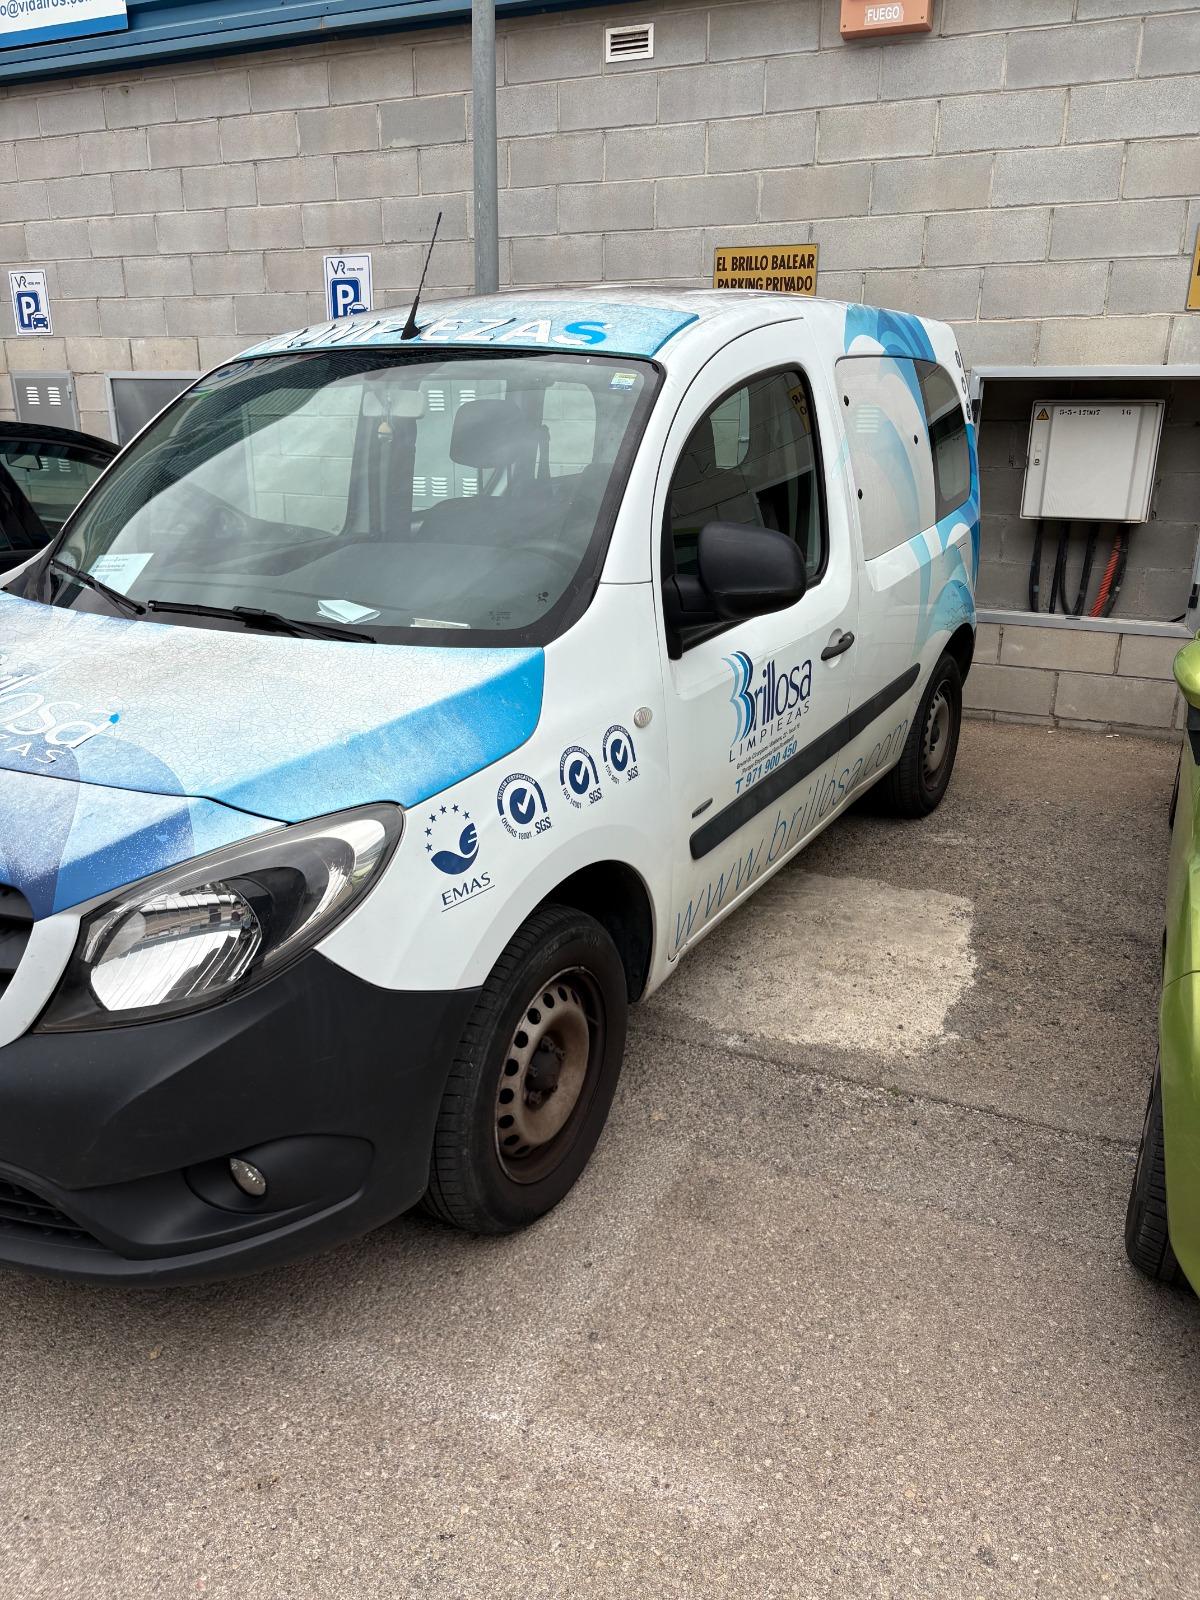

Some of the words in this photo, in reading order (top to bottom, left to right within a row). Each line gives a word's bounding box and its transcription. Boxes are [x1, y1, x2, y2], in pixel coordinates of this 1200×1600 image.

[867, 6, 900, 21] FUEGO
[330, 260, 346, 274] VR
[716, 256, 727, 271] EL
[731, 255, 768, 271] BRILLO
[771, 253, 815, 270] BALEAR
[718, 277, 764, 290] PARKING
[766, 275, 813, 291] PRIVADO
[20, 296, 35, 324] P
[336, 284, 355, 316] P
[721, 650, 813, 747] Brillosa
[729, 700, 810, 763] LIMPIEZAS
[627, 765, 639, 781] SGS
[736, 777, 744, 794] T
[746, 764, 763, 787] 971
[764, 752, 780, 774] 900
[782, 739, 798, 760] 450
[588, 787, 602, 805] SGS
[534, 816, 552, 835] SGS
[675, 719, 910, 949] www.brillosa.com
[441, 871, 491, 906] EMAS
